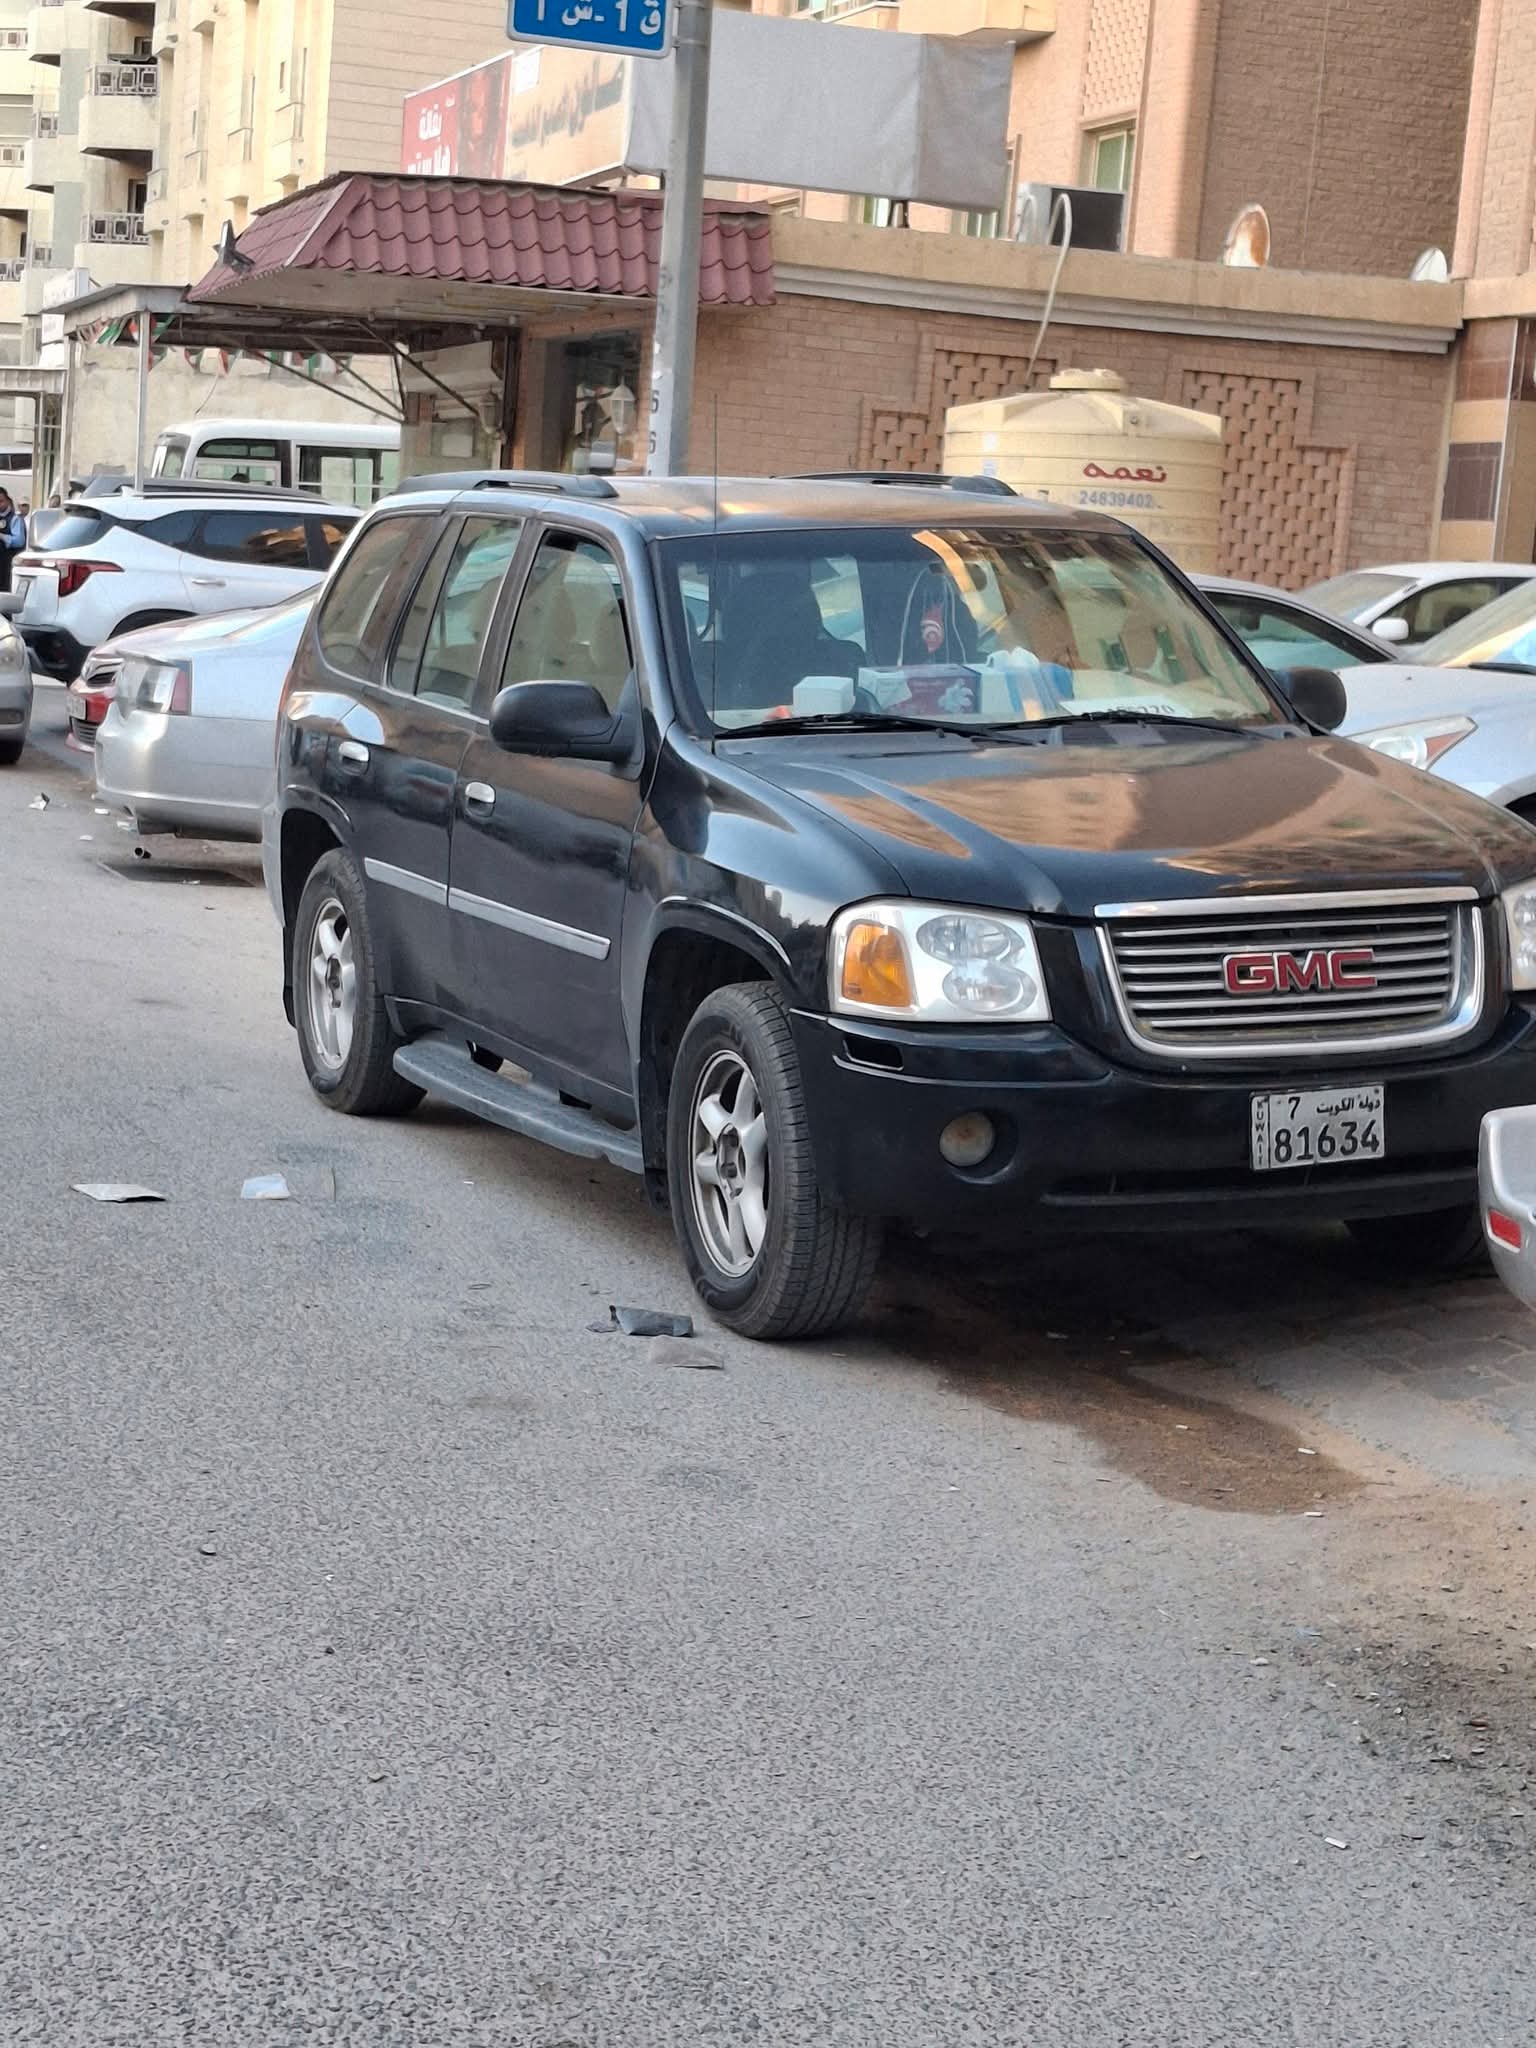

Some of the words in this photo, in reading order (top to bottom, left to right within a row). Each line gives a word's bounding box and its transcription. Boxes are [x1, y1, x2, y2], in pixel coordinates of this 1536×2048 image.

[640, 0, 661, 35] ق
[1223, 949, 1377, 993] GMC
[1288, 1096, 1300, 1120] 7
[1316, 1097, 1355, 1116] الكويت
[1256, 1101, 1265, 1165] KUWAIT
[1274, 1120, 1380, 1163] 81634
